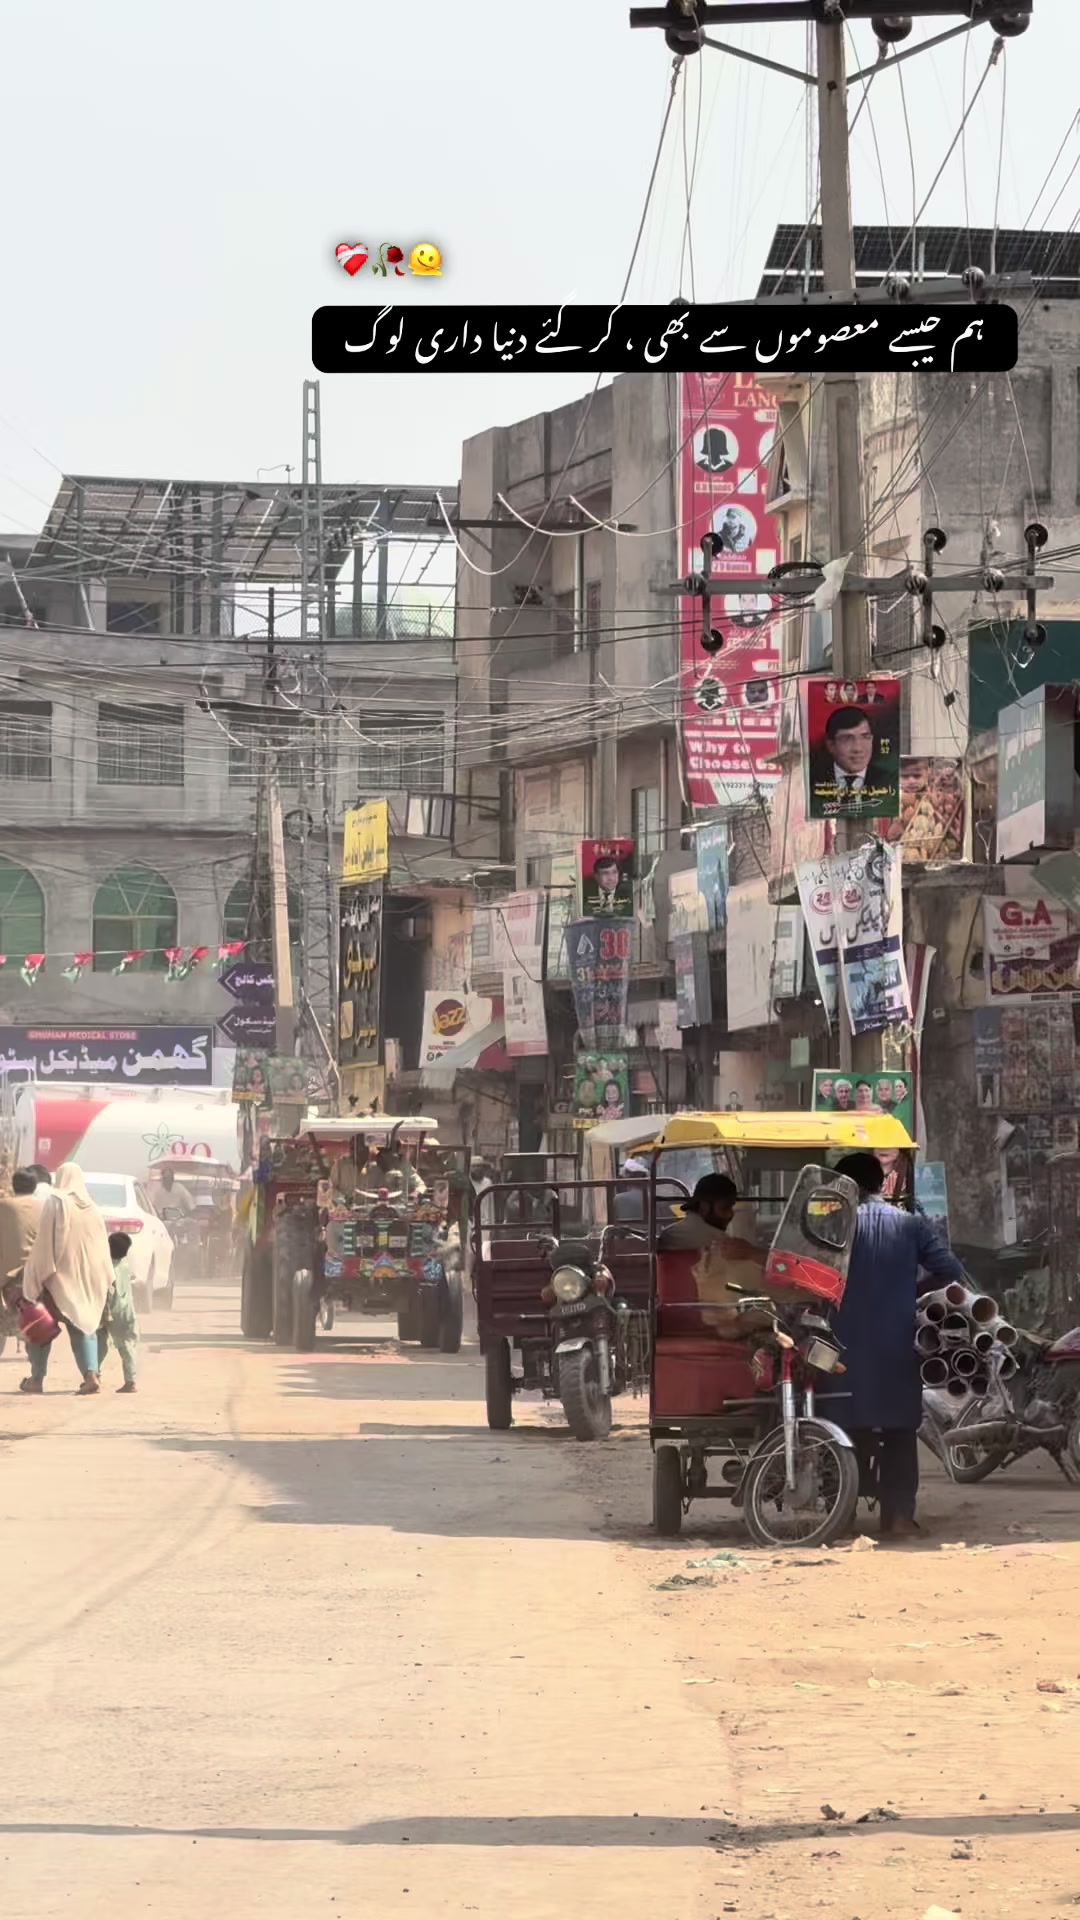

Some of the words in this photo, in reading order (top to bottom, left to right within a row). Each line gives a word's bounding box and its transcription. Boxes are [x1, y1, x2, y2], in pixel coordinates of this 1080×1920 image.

[688, 740, 727, 756] Why
[733, 742, 751, 755] to
[689, 756, 750, 770] Choose
[432, 1006, 465, 1037] Jazz
[40, 1044, 118, 1075] میڈیکل
[121, 1035, 209, 1077] گھمن
